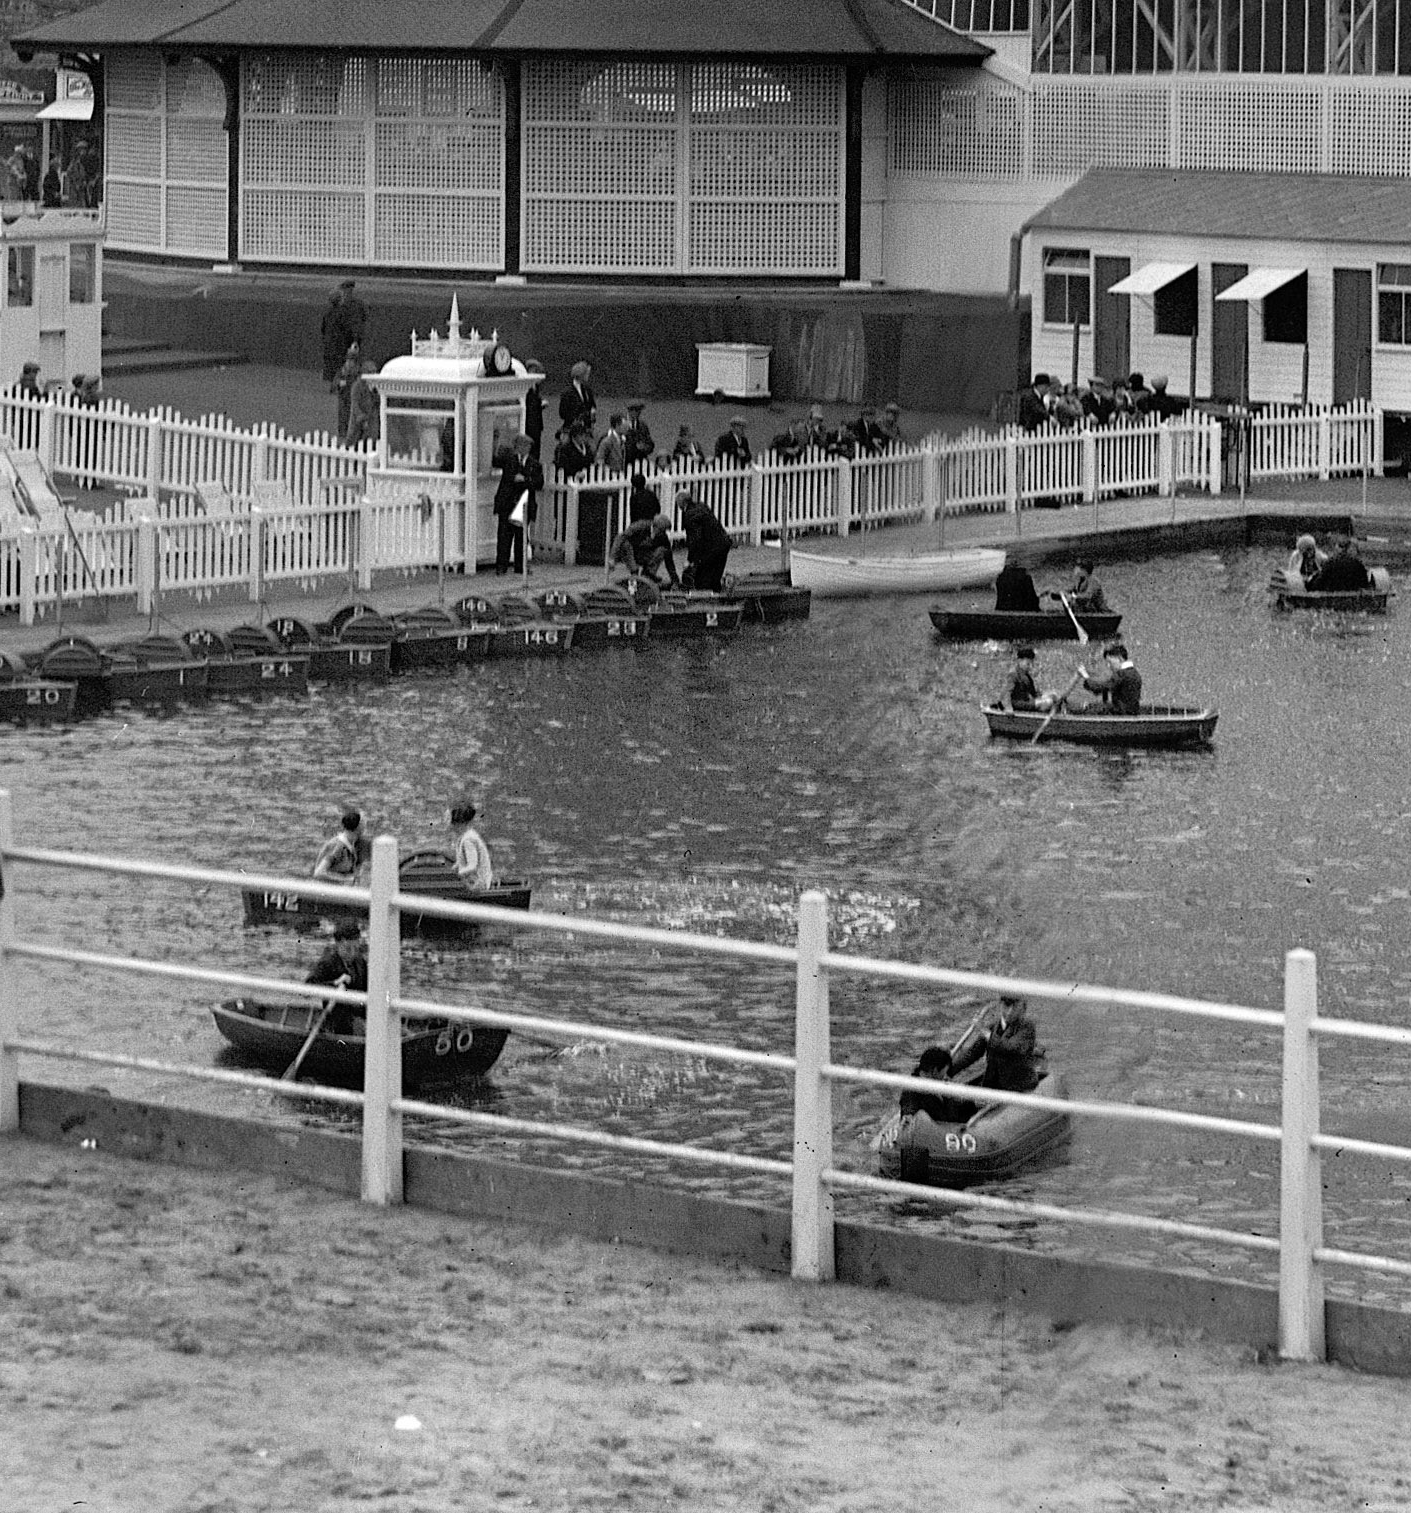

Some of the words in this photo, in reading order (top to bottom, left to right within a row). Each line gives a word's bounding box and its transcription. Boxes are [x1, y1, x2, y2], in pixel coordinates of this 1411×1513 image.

[524, 628, 559, 646] 146
[260, 662, 292, 680] 24
[26, 687, 60, 705] 20
